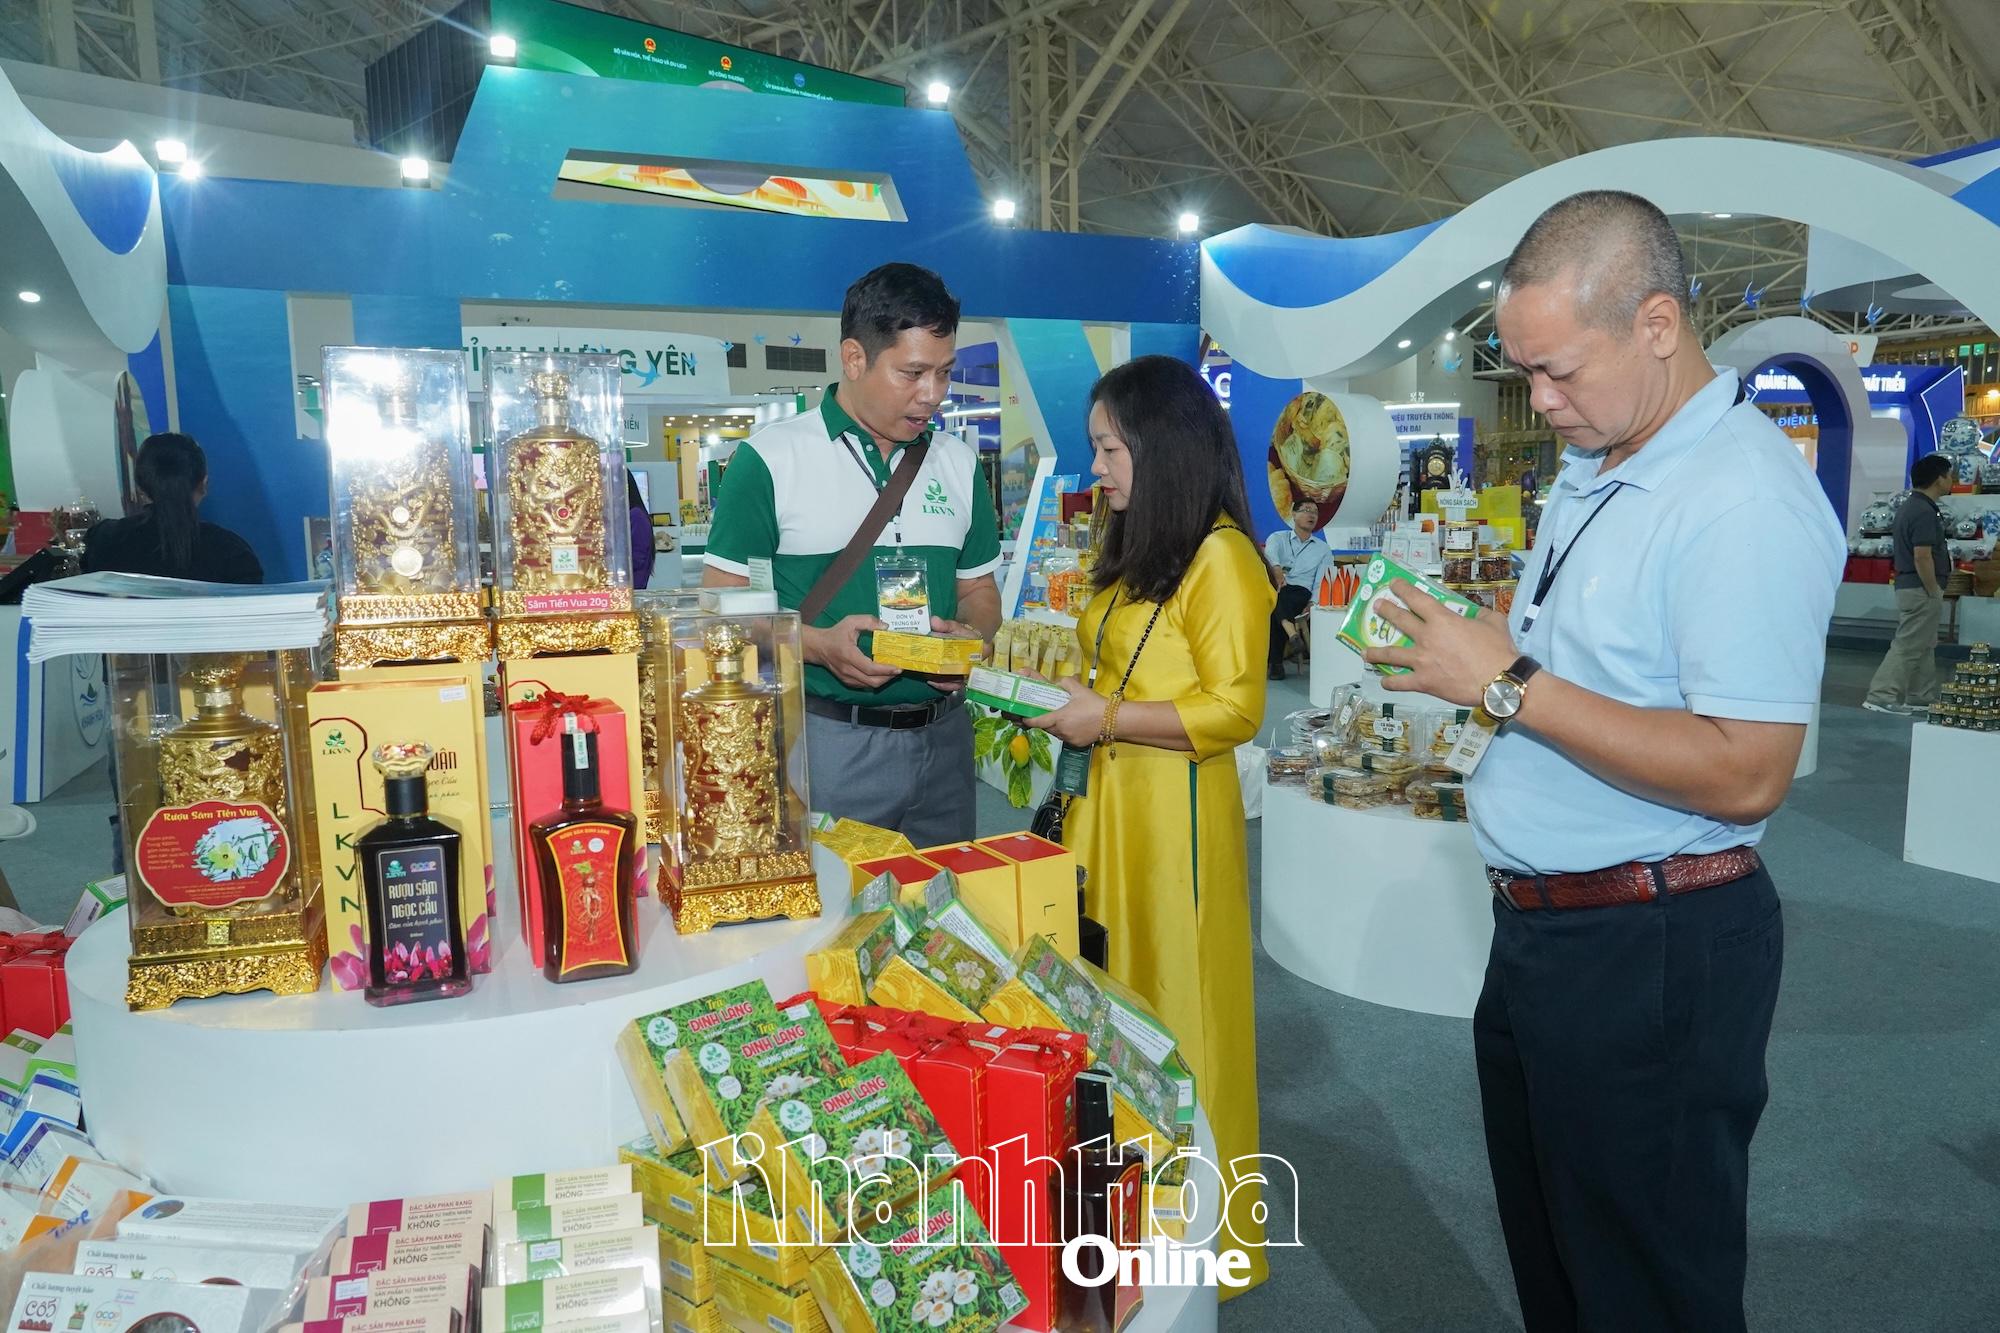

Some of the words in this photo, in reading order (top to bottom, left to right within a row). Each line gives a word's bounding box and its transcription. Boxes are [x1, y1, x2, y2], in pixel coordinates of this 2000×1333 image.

[645, 344, 696, 376] YÊN
[922, 504, 956, 517] LKVN
[527, 600, 548, 610] Sâm
[550, 598, 569, 608] Tiến
[569, 599, 588, 608] Vua
[590, 597, 608, 609] 20g
[322, 748, 352, 756] LKVN
[163, 813, 189, 822] Rượu
[191, 811, 214, 820] Sâm
[239, 808, 259, 816] Vua
[388, 883, 414, 900] RƯỢU
[416, 879, 438, 896] SÂM
[392, 902, 417, 920] NGỌC
[555, 1190, 583, 1200] KHÔNG
[407, 1219, 440, 1230] KHÔNG
[562, 1222, 592, 1233] KHÔNG
[393, 1254, 428, 1265] KHÔNG
[574, 1256, 606, 1268] KHÔNG
[373, 1296, 411, 1308] KHÔNG
[556, 1299, 589, 1311] KHÔNG
